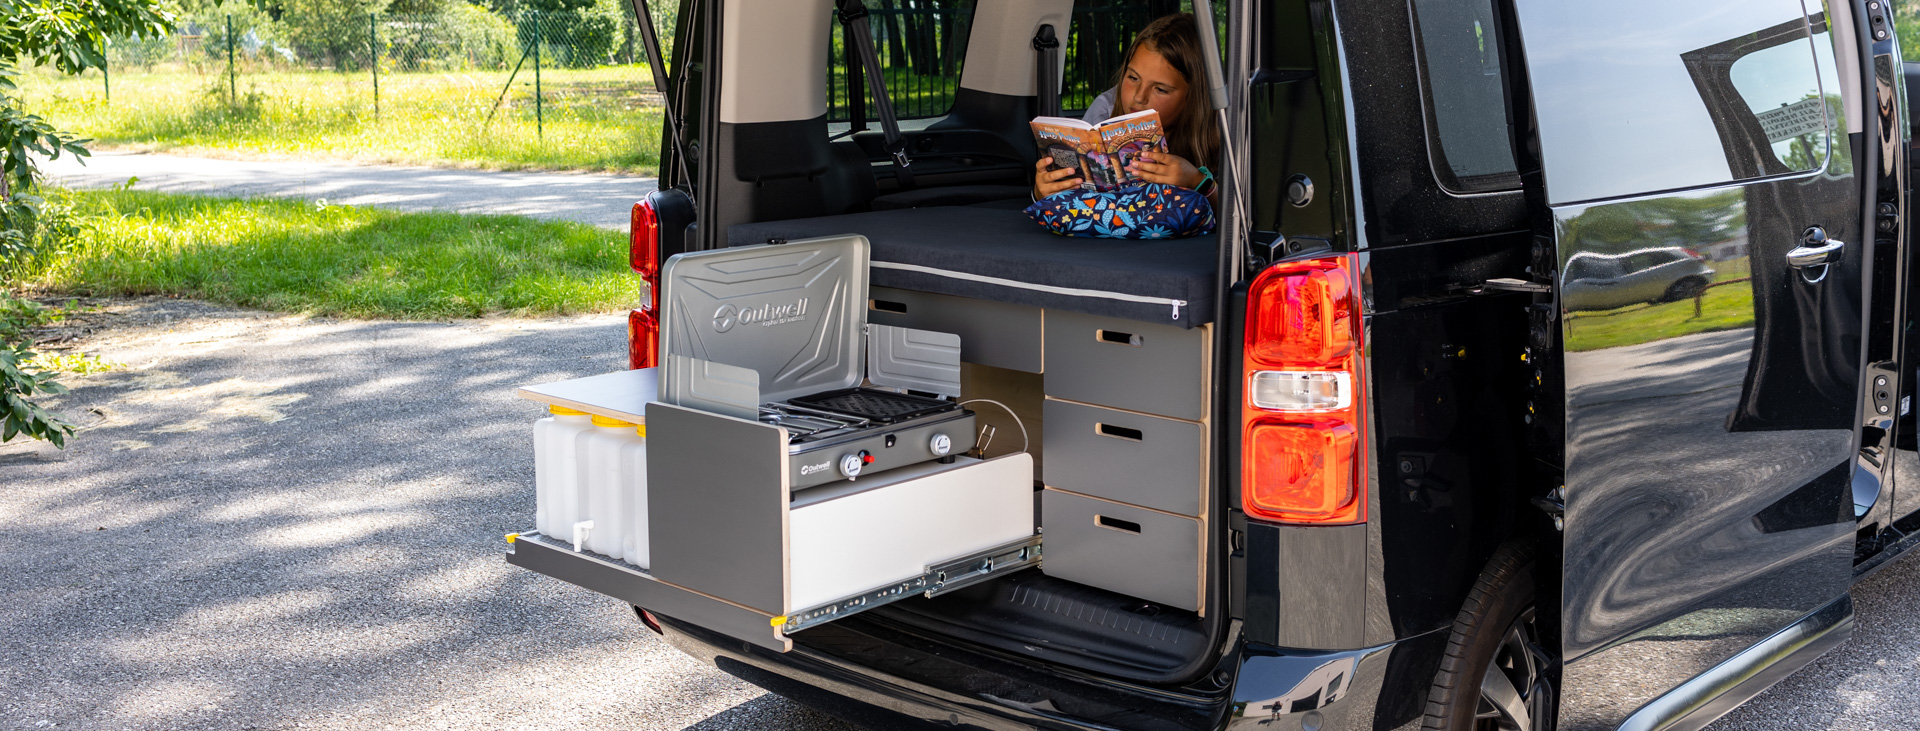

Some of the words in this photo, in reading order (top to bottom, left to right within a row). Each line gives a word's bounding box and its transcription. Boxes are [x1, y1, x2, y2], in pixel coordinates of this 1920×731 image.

[1038, 130, 1058, 140] Harry
[1058, 131, 1081, 143] Potter
[1101, 126, 1127, 142] Harry
[1127, 120, 1157, 134] Potter
[738, 297, 808, 326] Outwell
[808, 460, 831, 472] Outwell
